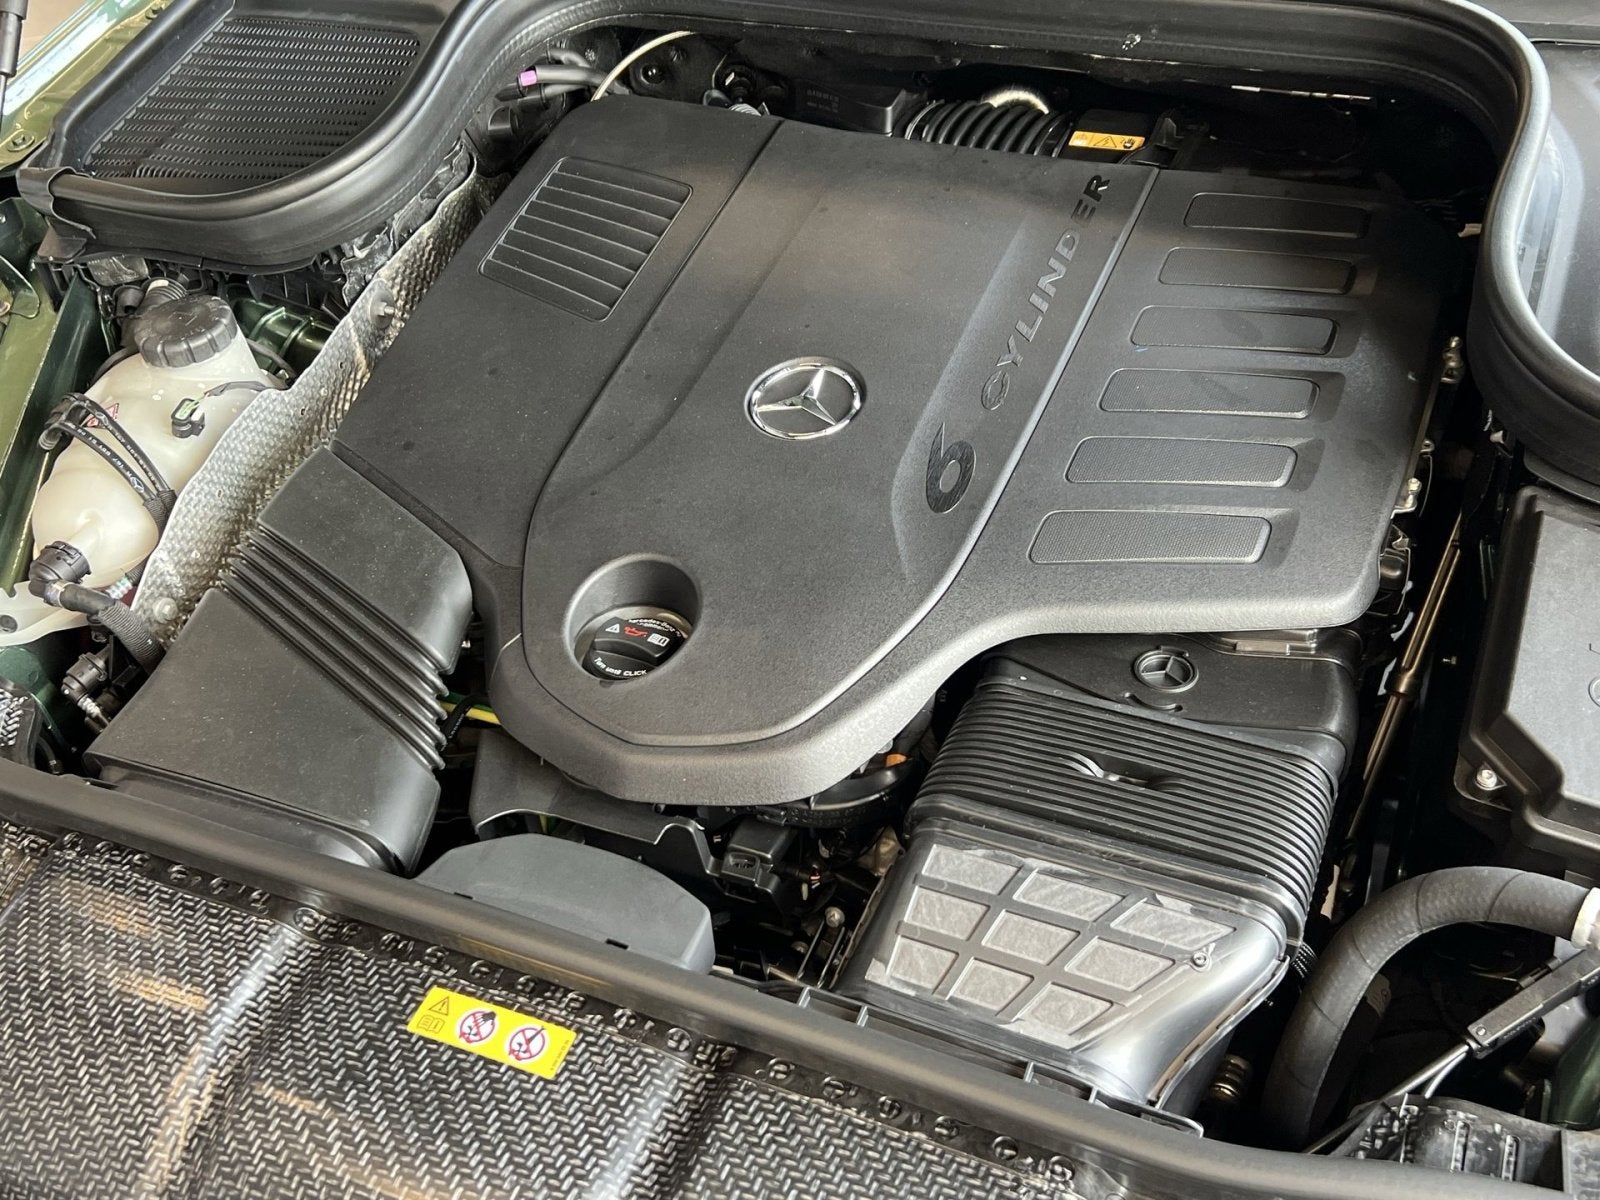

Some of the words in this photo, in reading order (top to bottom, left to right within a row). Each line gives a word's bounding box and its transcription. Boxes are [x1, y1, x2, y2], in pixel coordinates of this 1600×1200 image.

[926, 421, 976, 514] 6
[980, 174, 1111, 411] CYLINDER
[594, 656, 607, 669] Turn
[623, 669, 647, 677] CLICK
